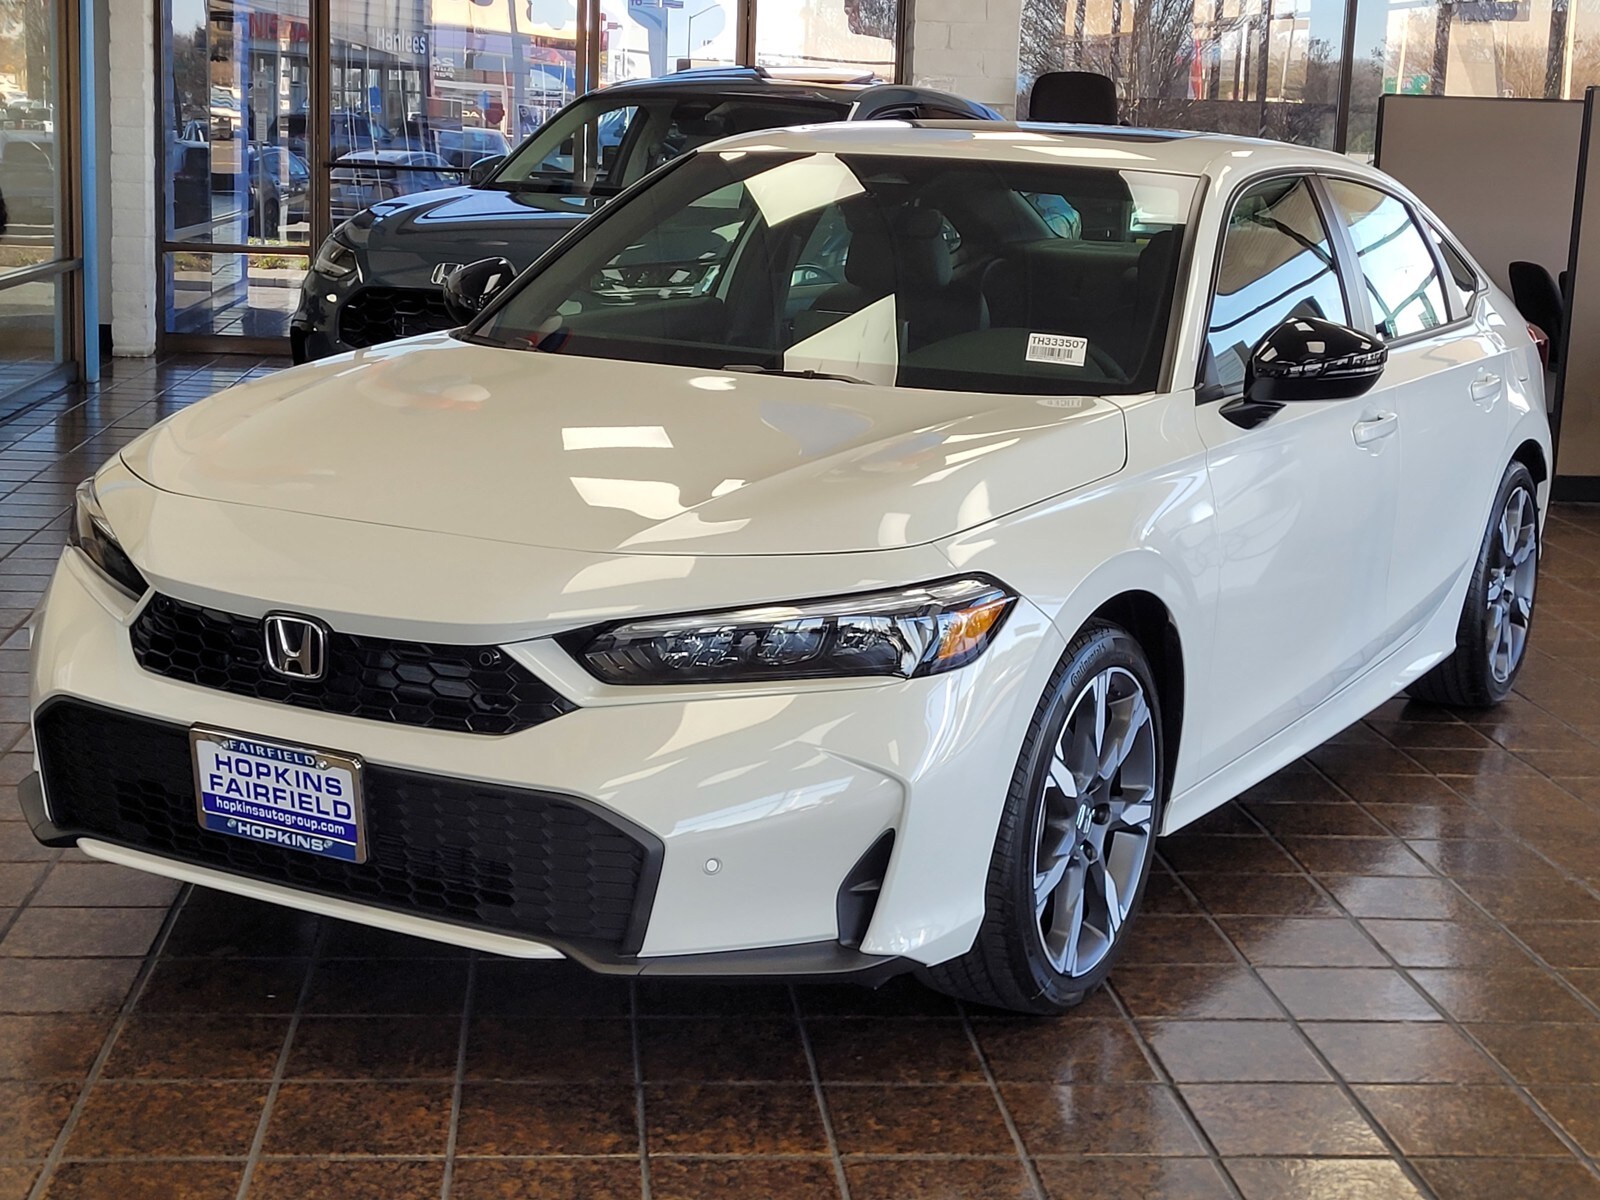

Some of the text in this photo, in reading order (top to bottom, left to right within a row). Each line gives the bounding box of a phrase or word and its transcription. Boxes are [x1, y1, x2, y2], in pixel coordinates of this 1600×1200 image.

[376, 28, 426, 54] Hanlees
[1031, 336, 1086, 350] TH333507
[1071, 643, 1102, 687] Continental
[229, 740, 315, 766] FAIRFIELD
[214, 753, 343, 796] HOPKINS
[209, 773, 352, 820] FAIRFIELD
[216, 797, 345, 835] hopkinsautogroup.com
[237, 822, 324, 851] HOPKINS
